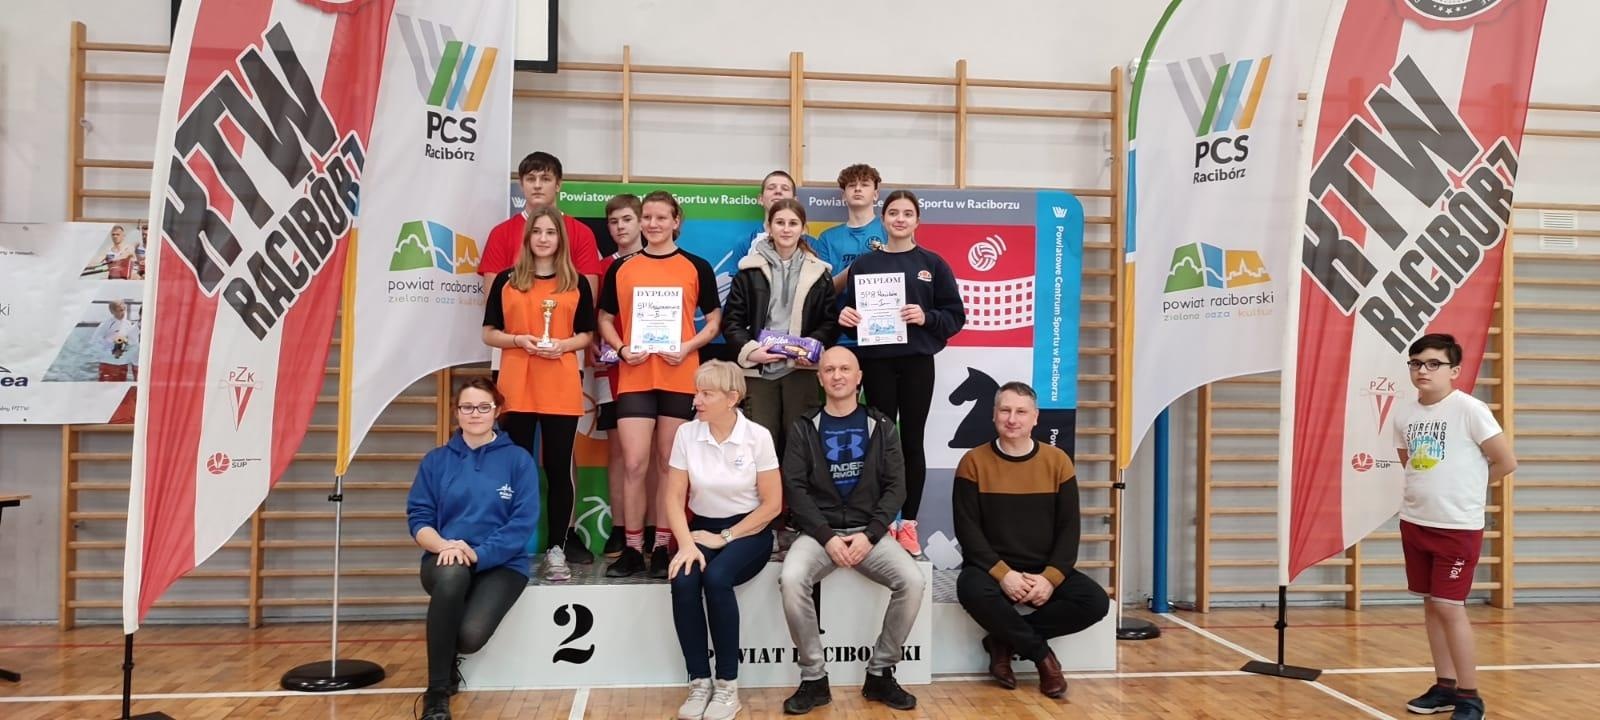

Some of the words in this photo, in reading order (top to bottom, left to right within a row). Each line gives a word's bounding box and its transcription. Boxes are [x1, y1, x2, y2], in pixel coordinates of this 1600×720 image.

[427, 111, 477, 143] PCS
[162, 22, 338, 293] KTW
[425, 144, 475, 161] Racibórz
[1195, 135, 1249, 168] PCS
[1193, 167, 1246, 184] Racibórz
[1302, 54, 1480, 312] KTW
[560, 192, 614, 202] Powiatow
[721, 195, 759, 205] Racibo
[809, 197, 847, 207] Powiat
[919, 199, 954, 210] Sportu
[967, 199, 1020, 210] Raciborzu
[1055, 225, 1065, 276] Powiatowe
[388, 277, 435, 294] powiat
[858, 276, 901, 285] DYPLOM
[1053, 276, 1063, 315] Centrum
[1163, 297, 1205, 313] powiat
[1210, 291, 1274, 306] raciborski
[1052, 317, 1062, 346] Sportu
[1052, 347, 1060, 356] w
[229, 367, 255, 383] PZK
[1051, 357, 1061, 401] Raciborzu
[1370, 377, 1395, 392] PZK
[1408, 421, 1447, 432] SURFING
[231, 461, 247, 469] SUP
[552, 603, 595, 664] 2
